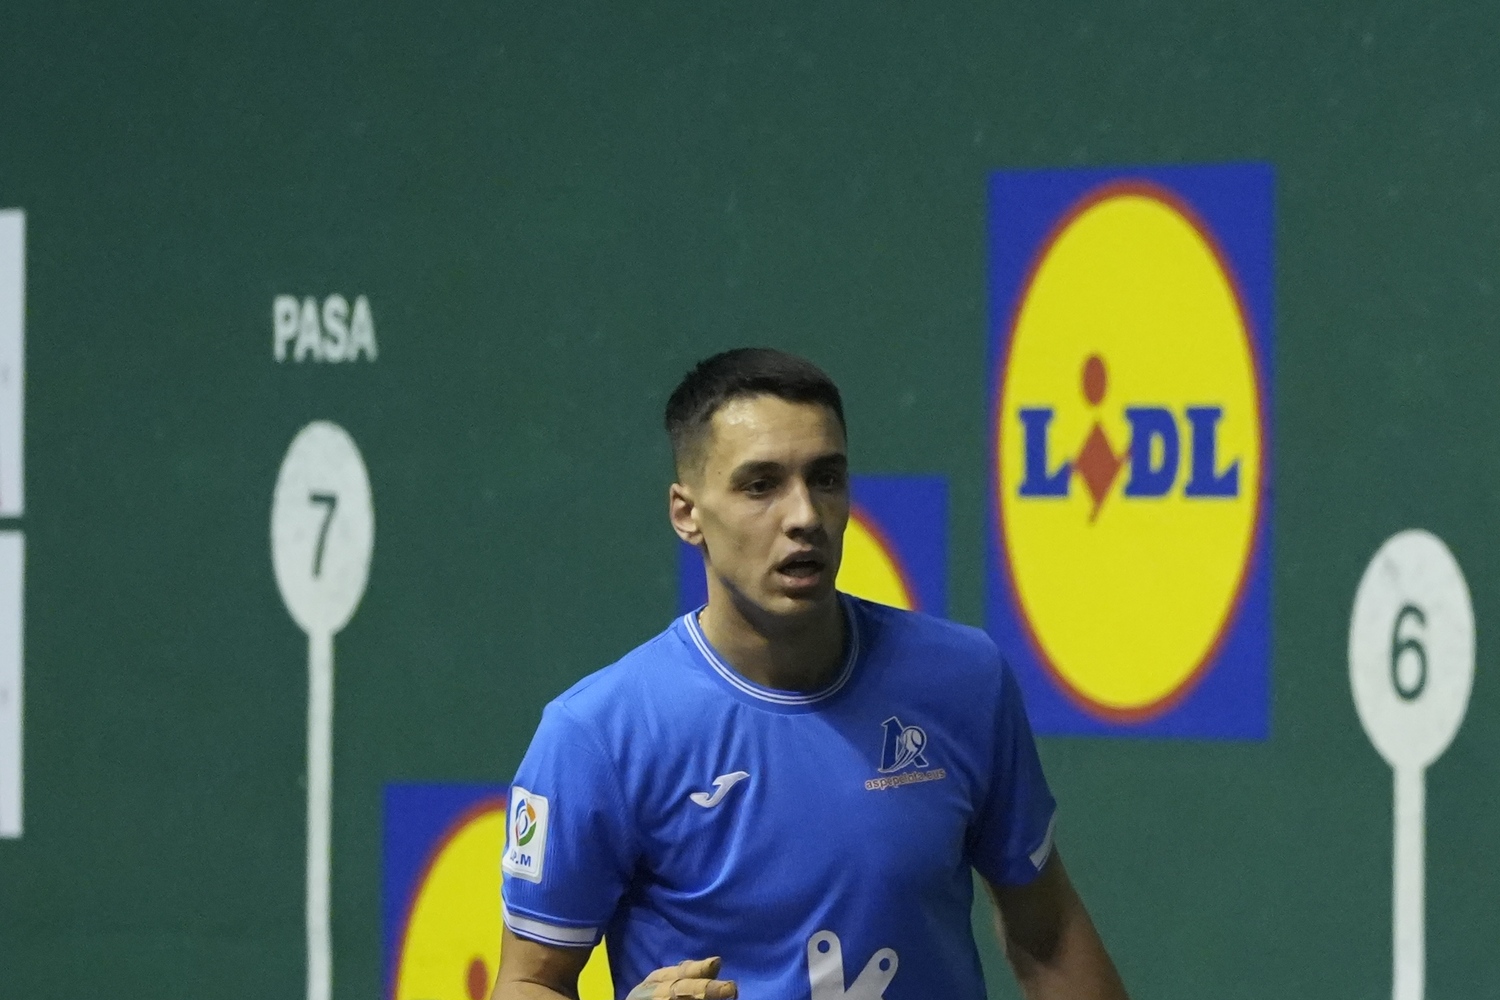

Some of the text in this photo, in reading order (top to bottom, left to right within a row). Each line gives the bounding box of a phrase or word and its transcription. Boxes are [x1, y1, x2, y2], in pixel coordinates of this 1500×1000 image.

[273, 293, 379, 363] PASA
[1018, 354, 1240, 525] LIDL
[308, 490, 339, 580] 7
[1390, 602, 1428, 702] 6
